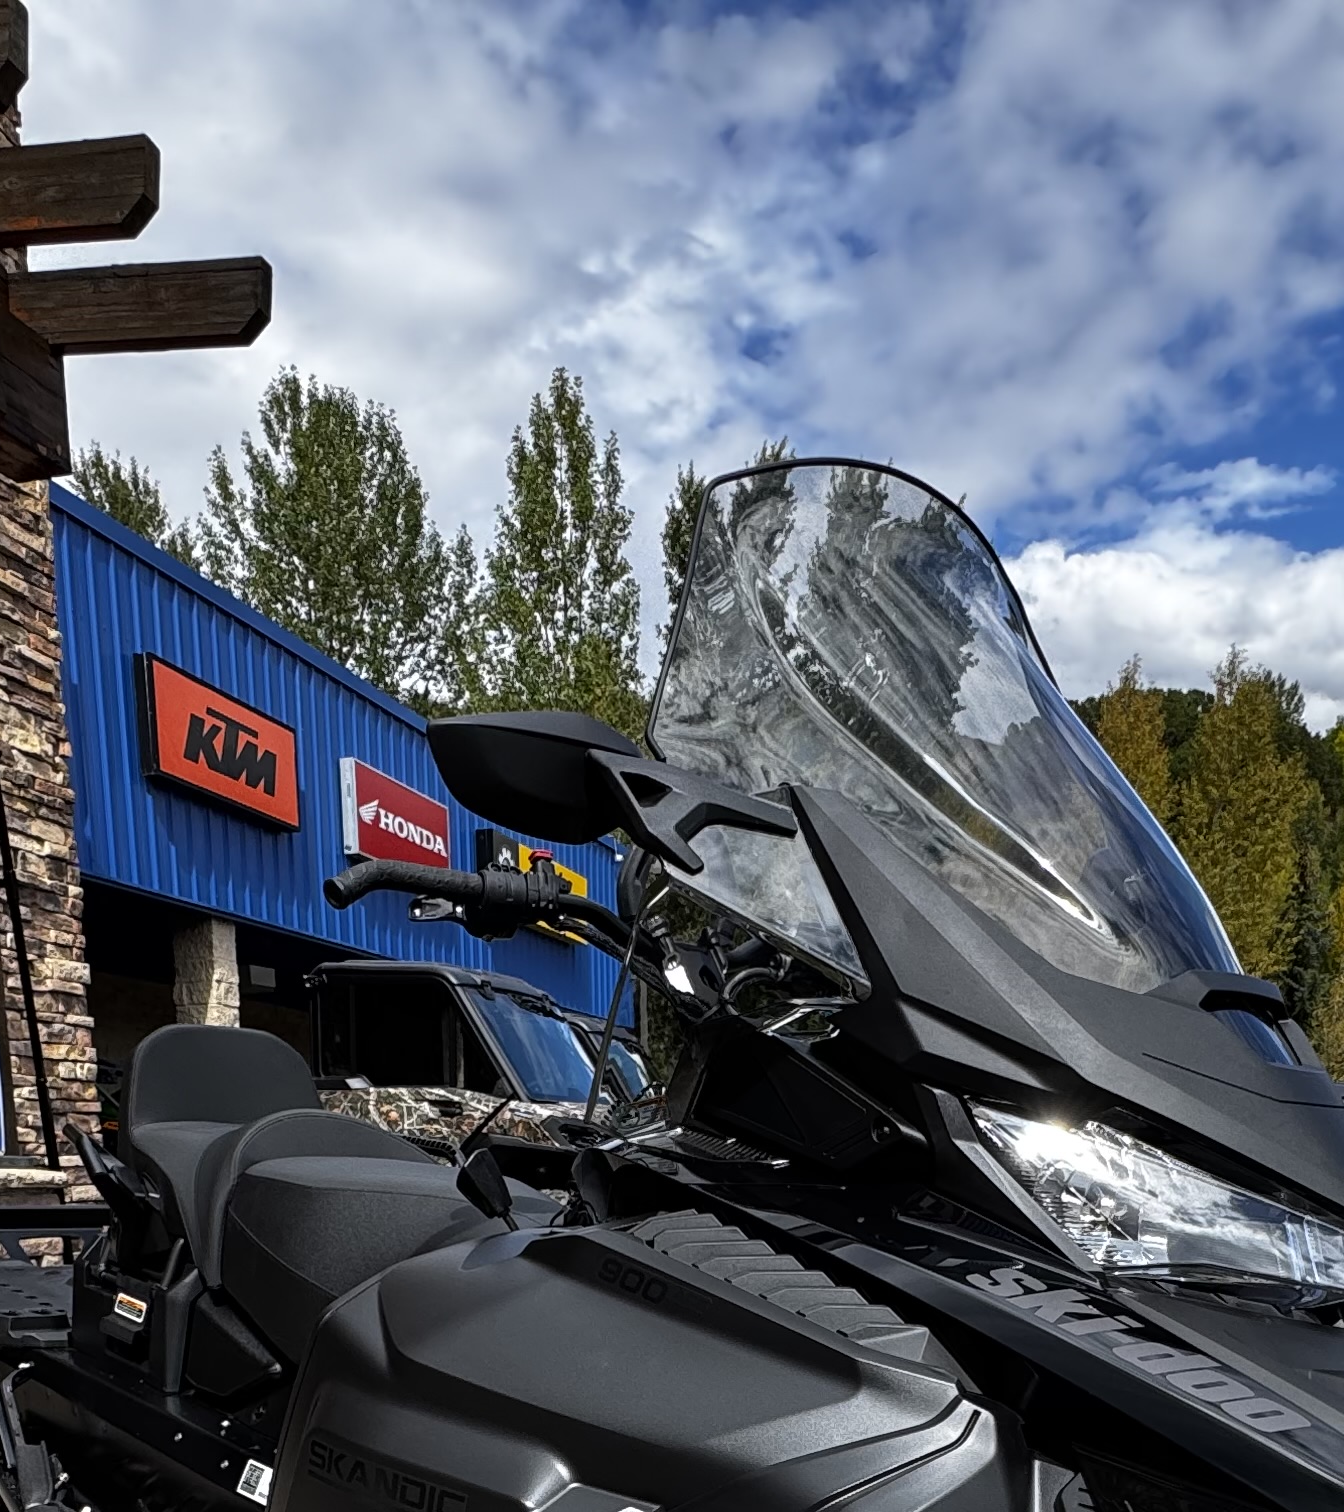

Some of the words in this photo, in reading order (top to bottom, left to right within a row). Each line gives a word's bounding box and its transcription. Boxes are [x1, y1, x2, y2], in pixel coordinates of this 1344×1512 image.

[183, 706, 277, 797] KTM
[377, 806, 448, 858] HONDA
[598, 1257, 668, 1304] 900
